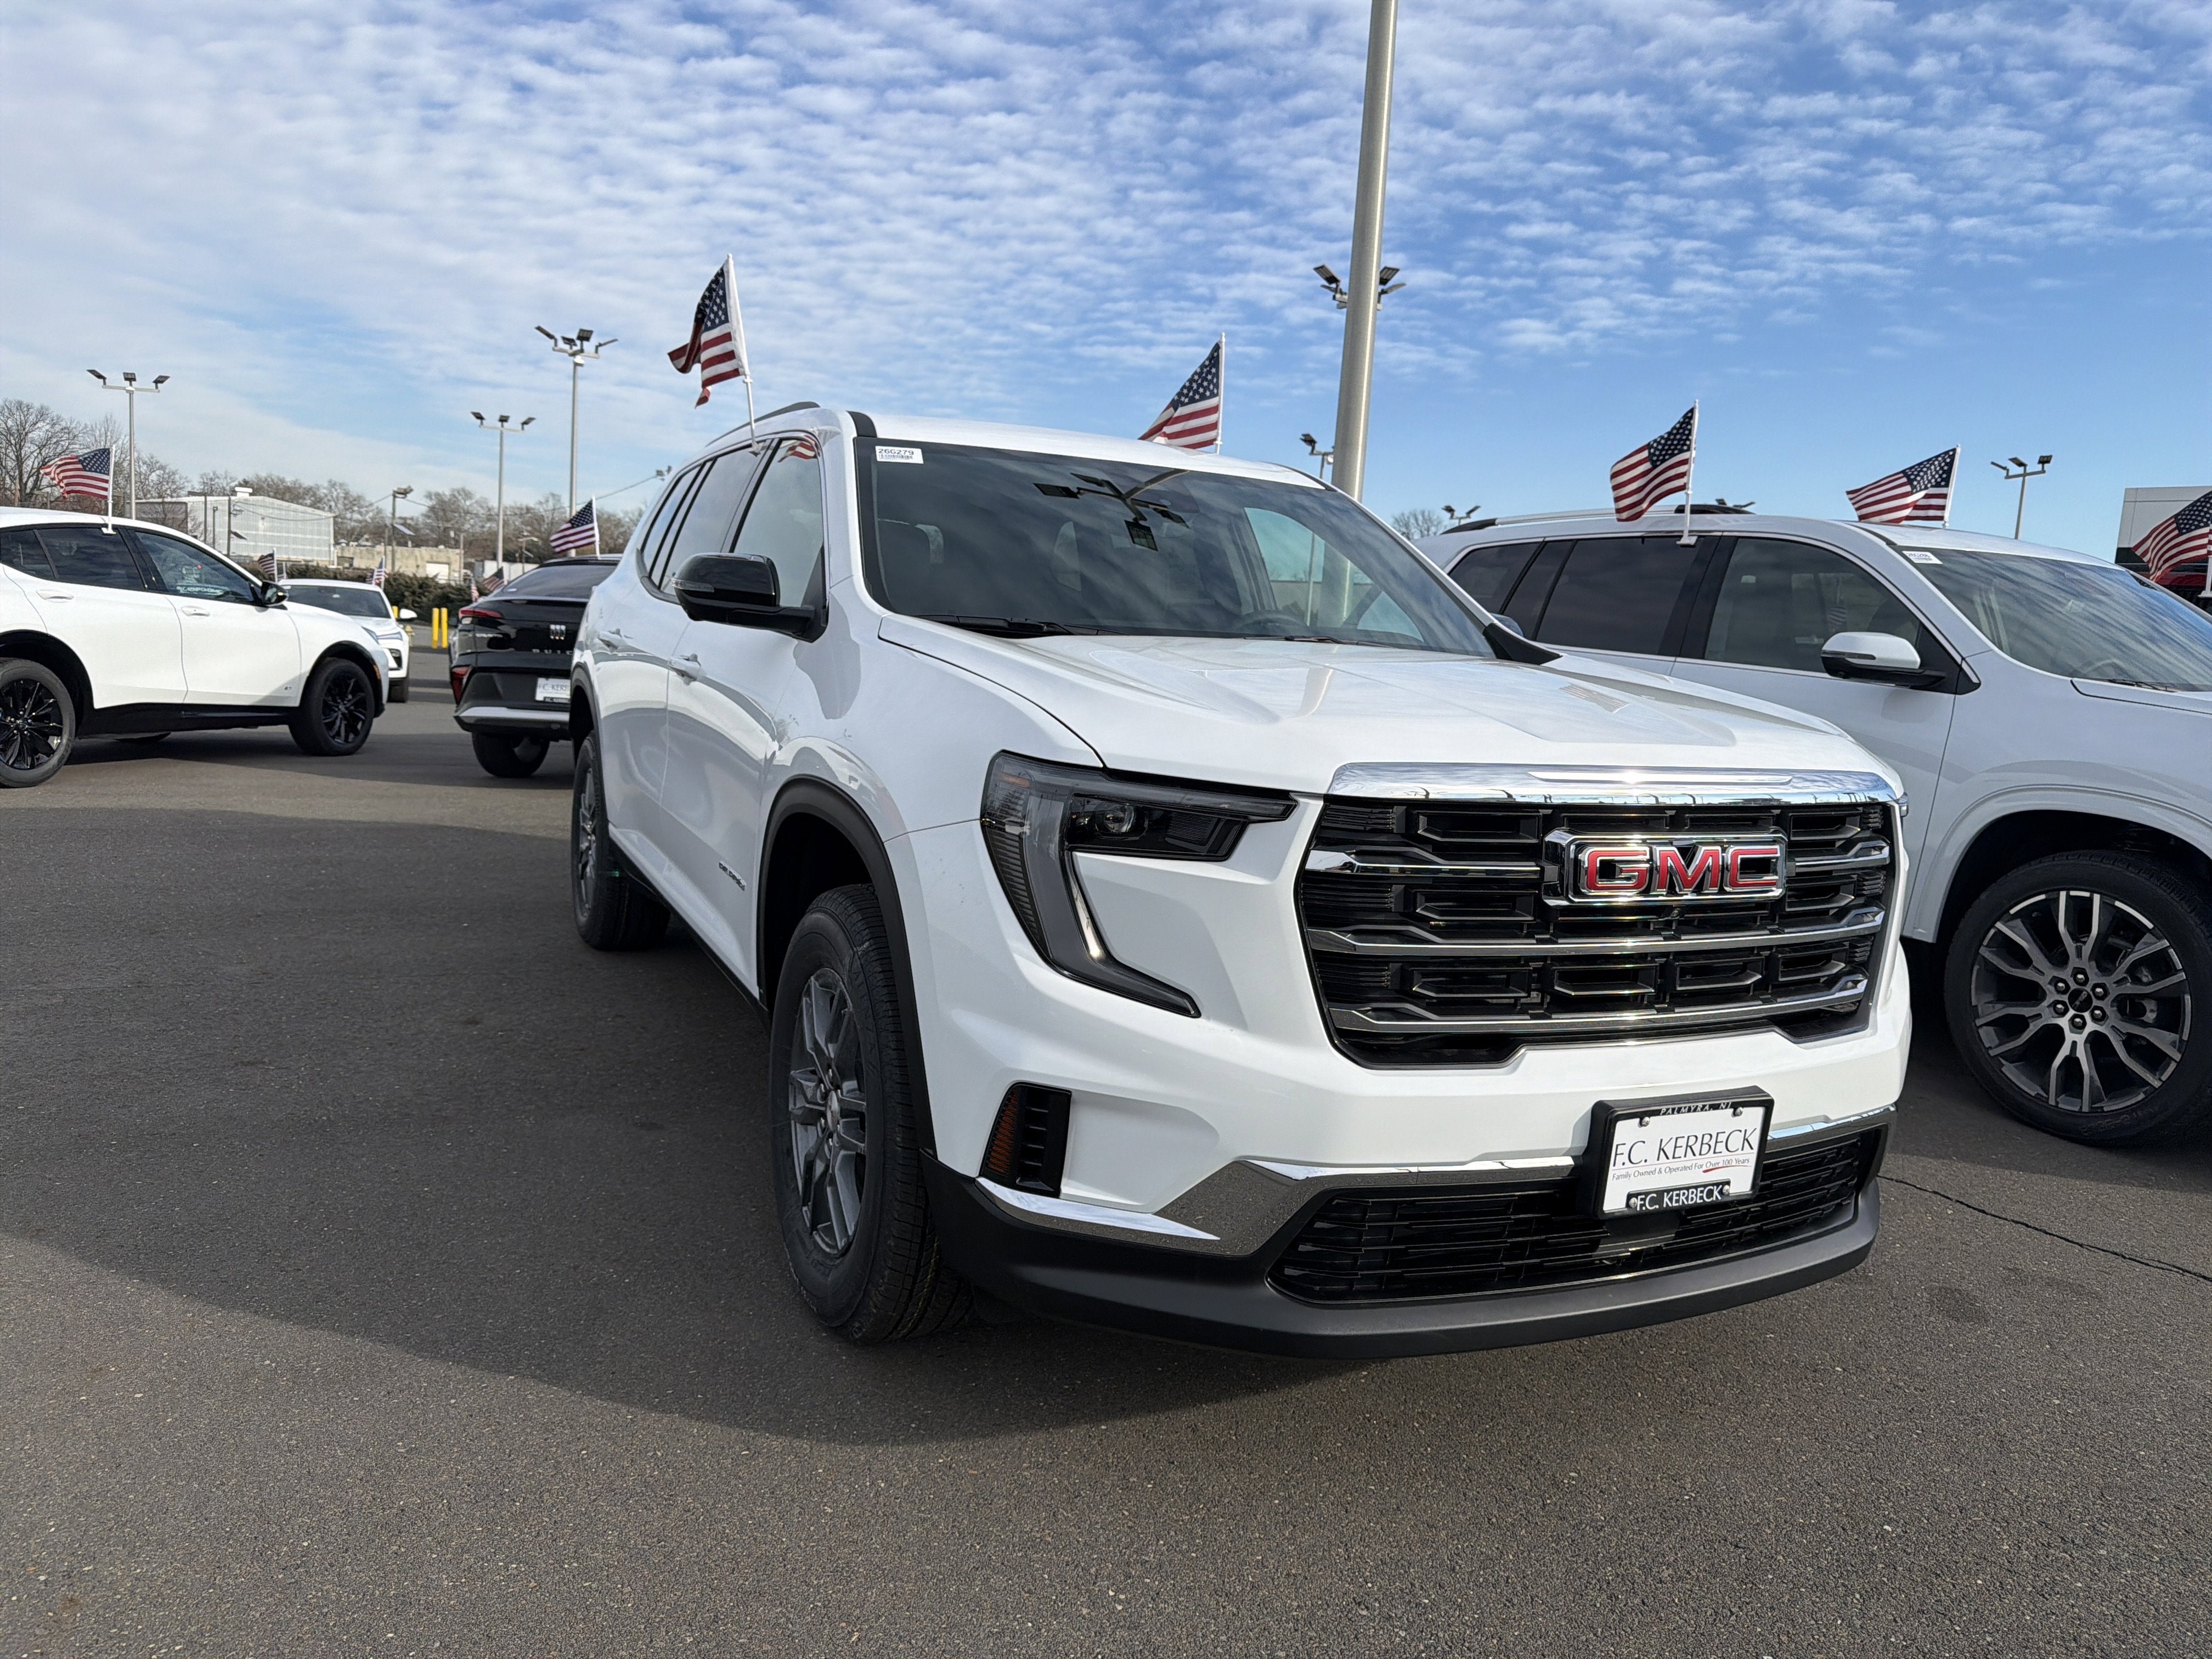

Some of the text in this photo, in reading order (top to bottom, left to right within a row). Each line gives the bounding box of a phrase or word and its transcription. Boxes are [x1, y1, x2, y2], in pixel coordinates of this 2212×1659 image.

[1578, 845, 1781, 895] GMC
[1660, 1104, 1713, 1115] PALMYRA,
[1612, 1127, 1757, 1167] F.C. KERBECK
[1612, 1171, 1632, 1181] Family
[1633, 1167, 1656, 1178] Owned
[1664, 1163, 1693, 1174] Operated
[1705, 1160, 1720, 1169] Over
[1734, 1157, 1750, 1165] Years
[1637, 1184, 1723, 1211] F.C. KERBECK
